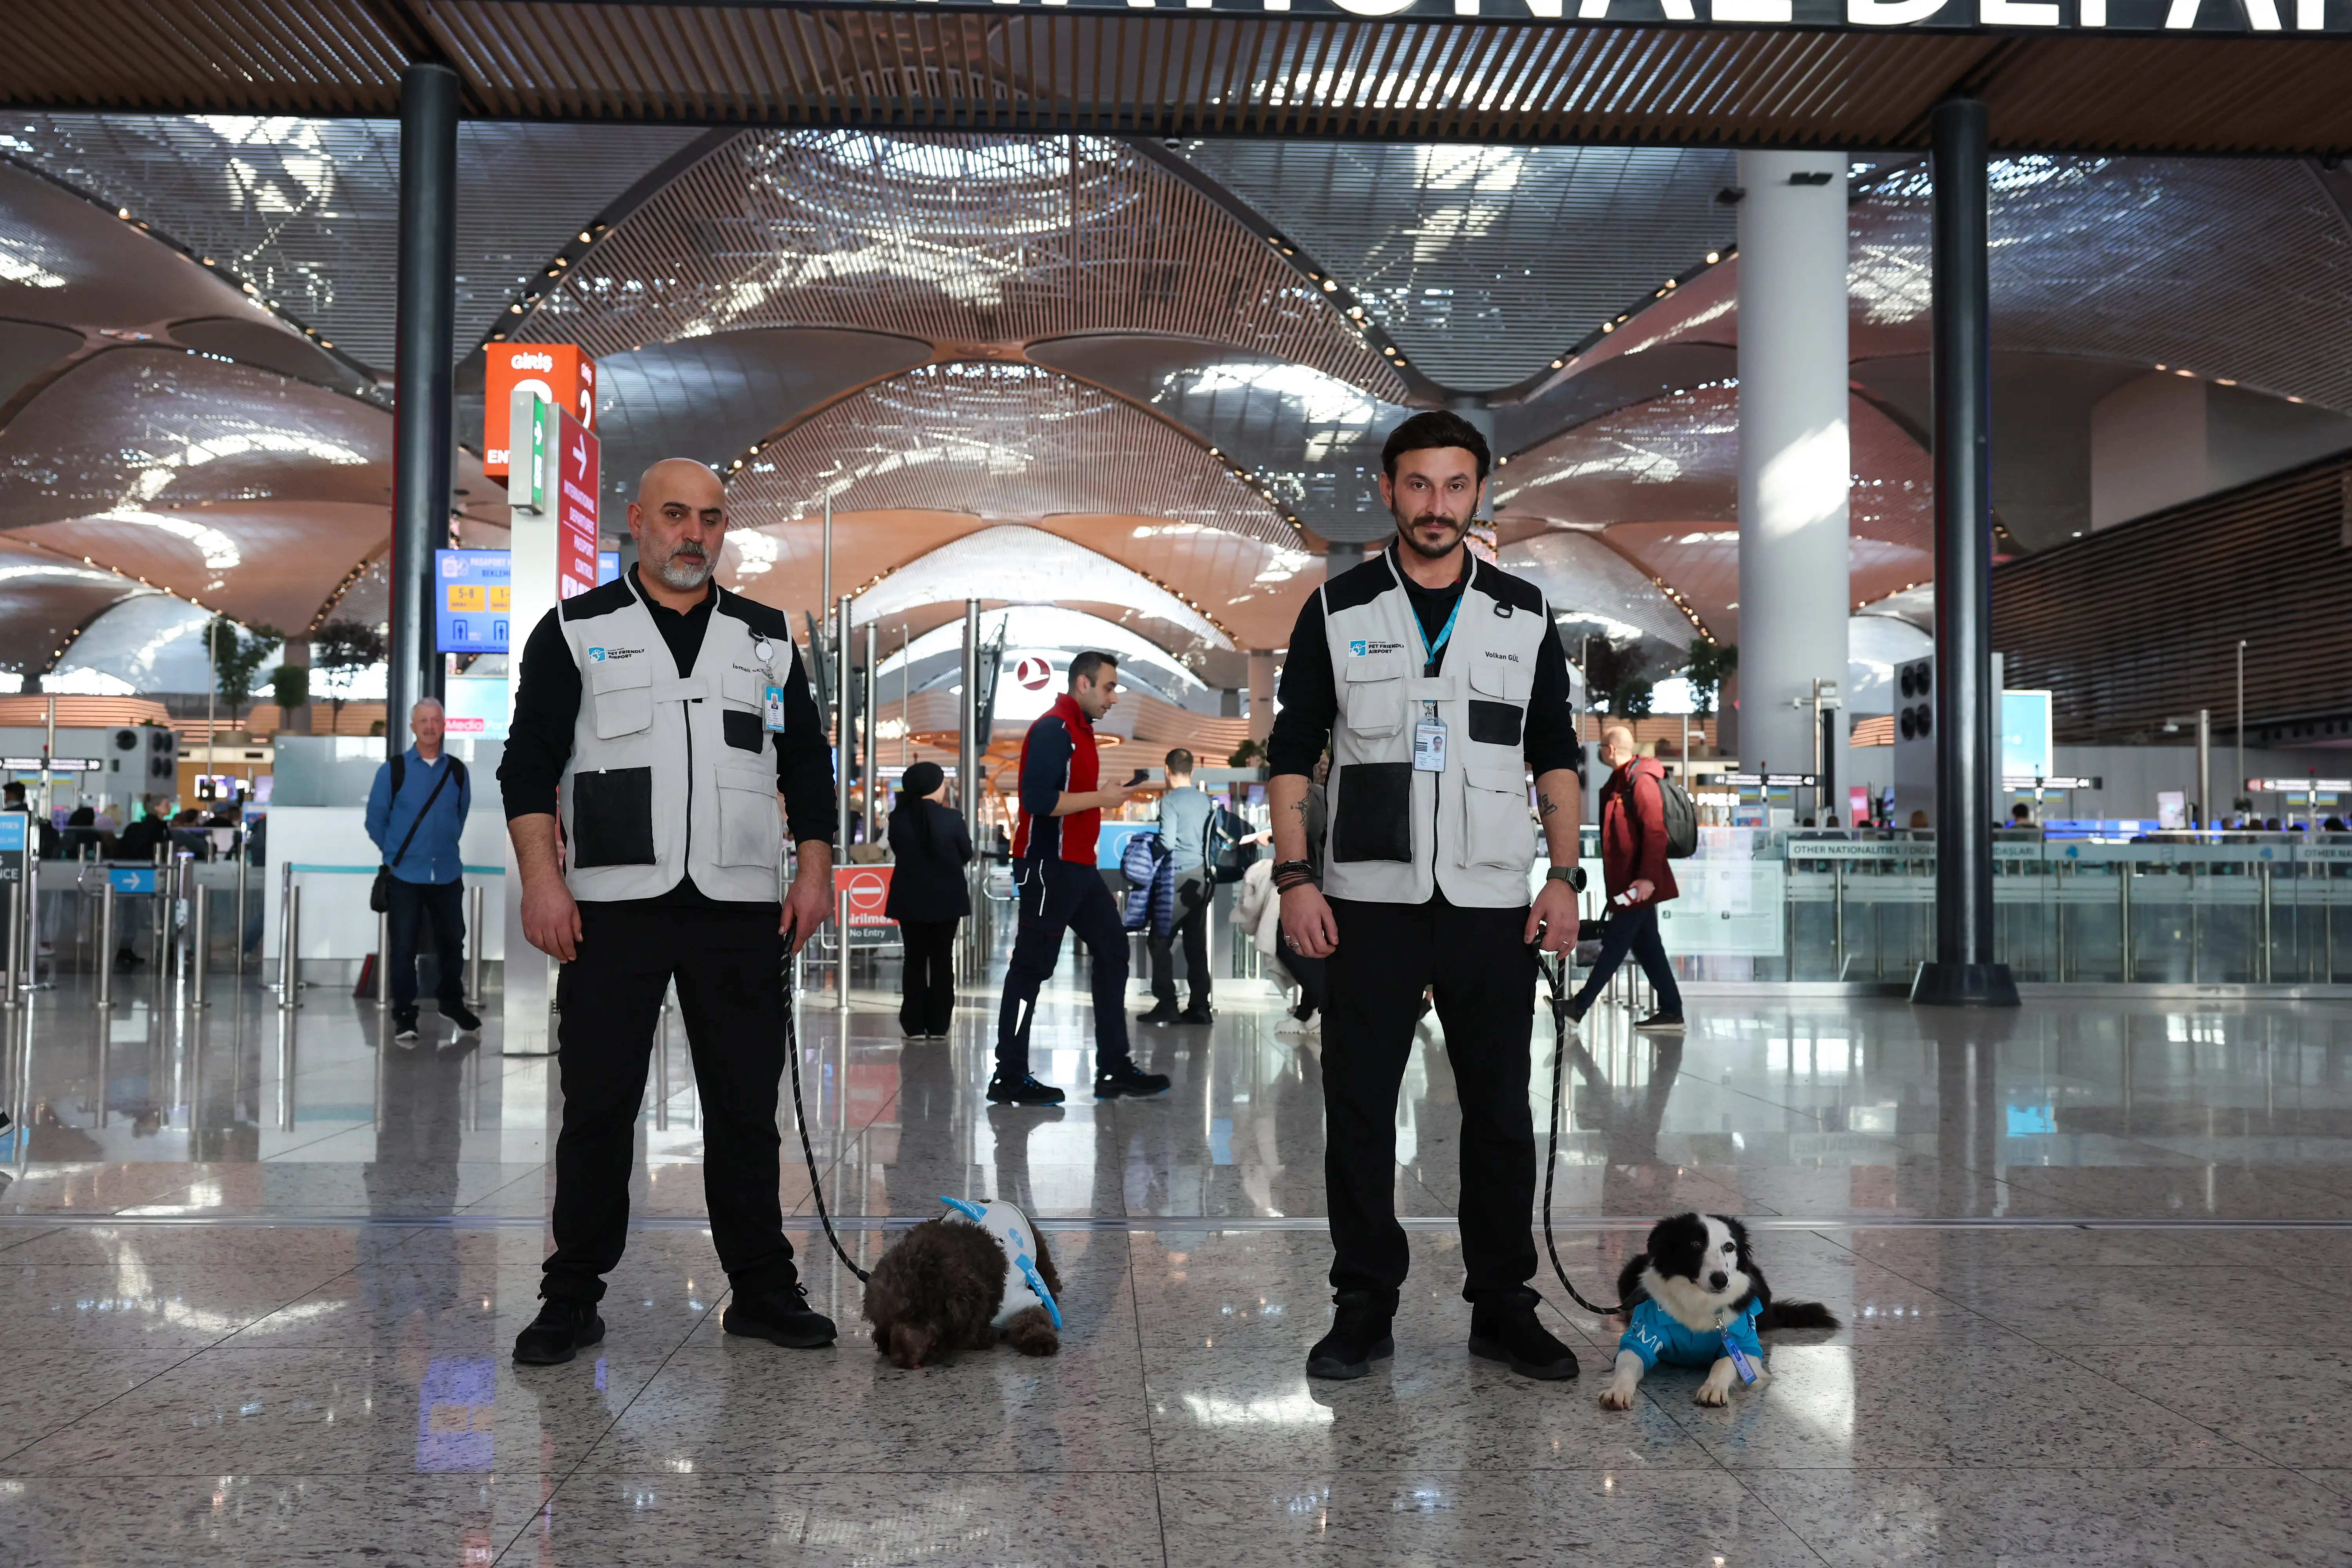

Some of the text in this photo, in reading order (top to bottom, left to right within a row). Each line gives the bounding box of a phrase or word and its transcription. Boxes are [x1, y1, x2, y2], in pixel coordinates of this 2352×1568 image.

[511, 352, 553, 373] GİRİŞ
[487, 449, 510, 463] EN
[1485, 651, 1519, 662] Volkan GÜL
[1794, 846, 1826, 854] OTHER
[1829, 846, 1899, 855] NATIONALITIES
[849, 928, 886, 938] No Entry
